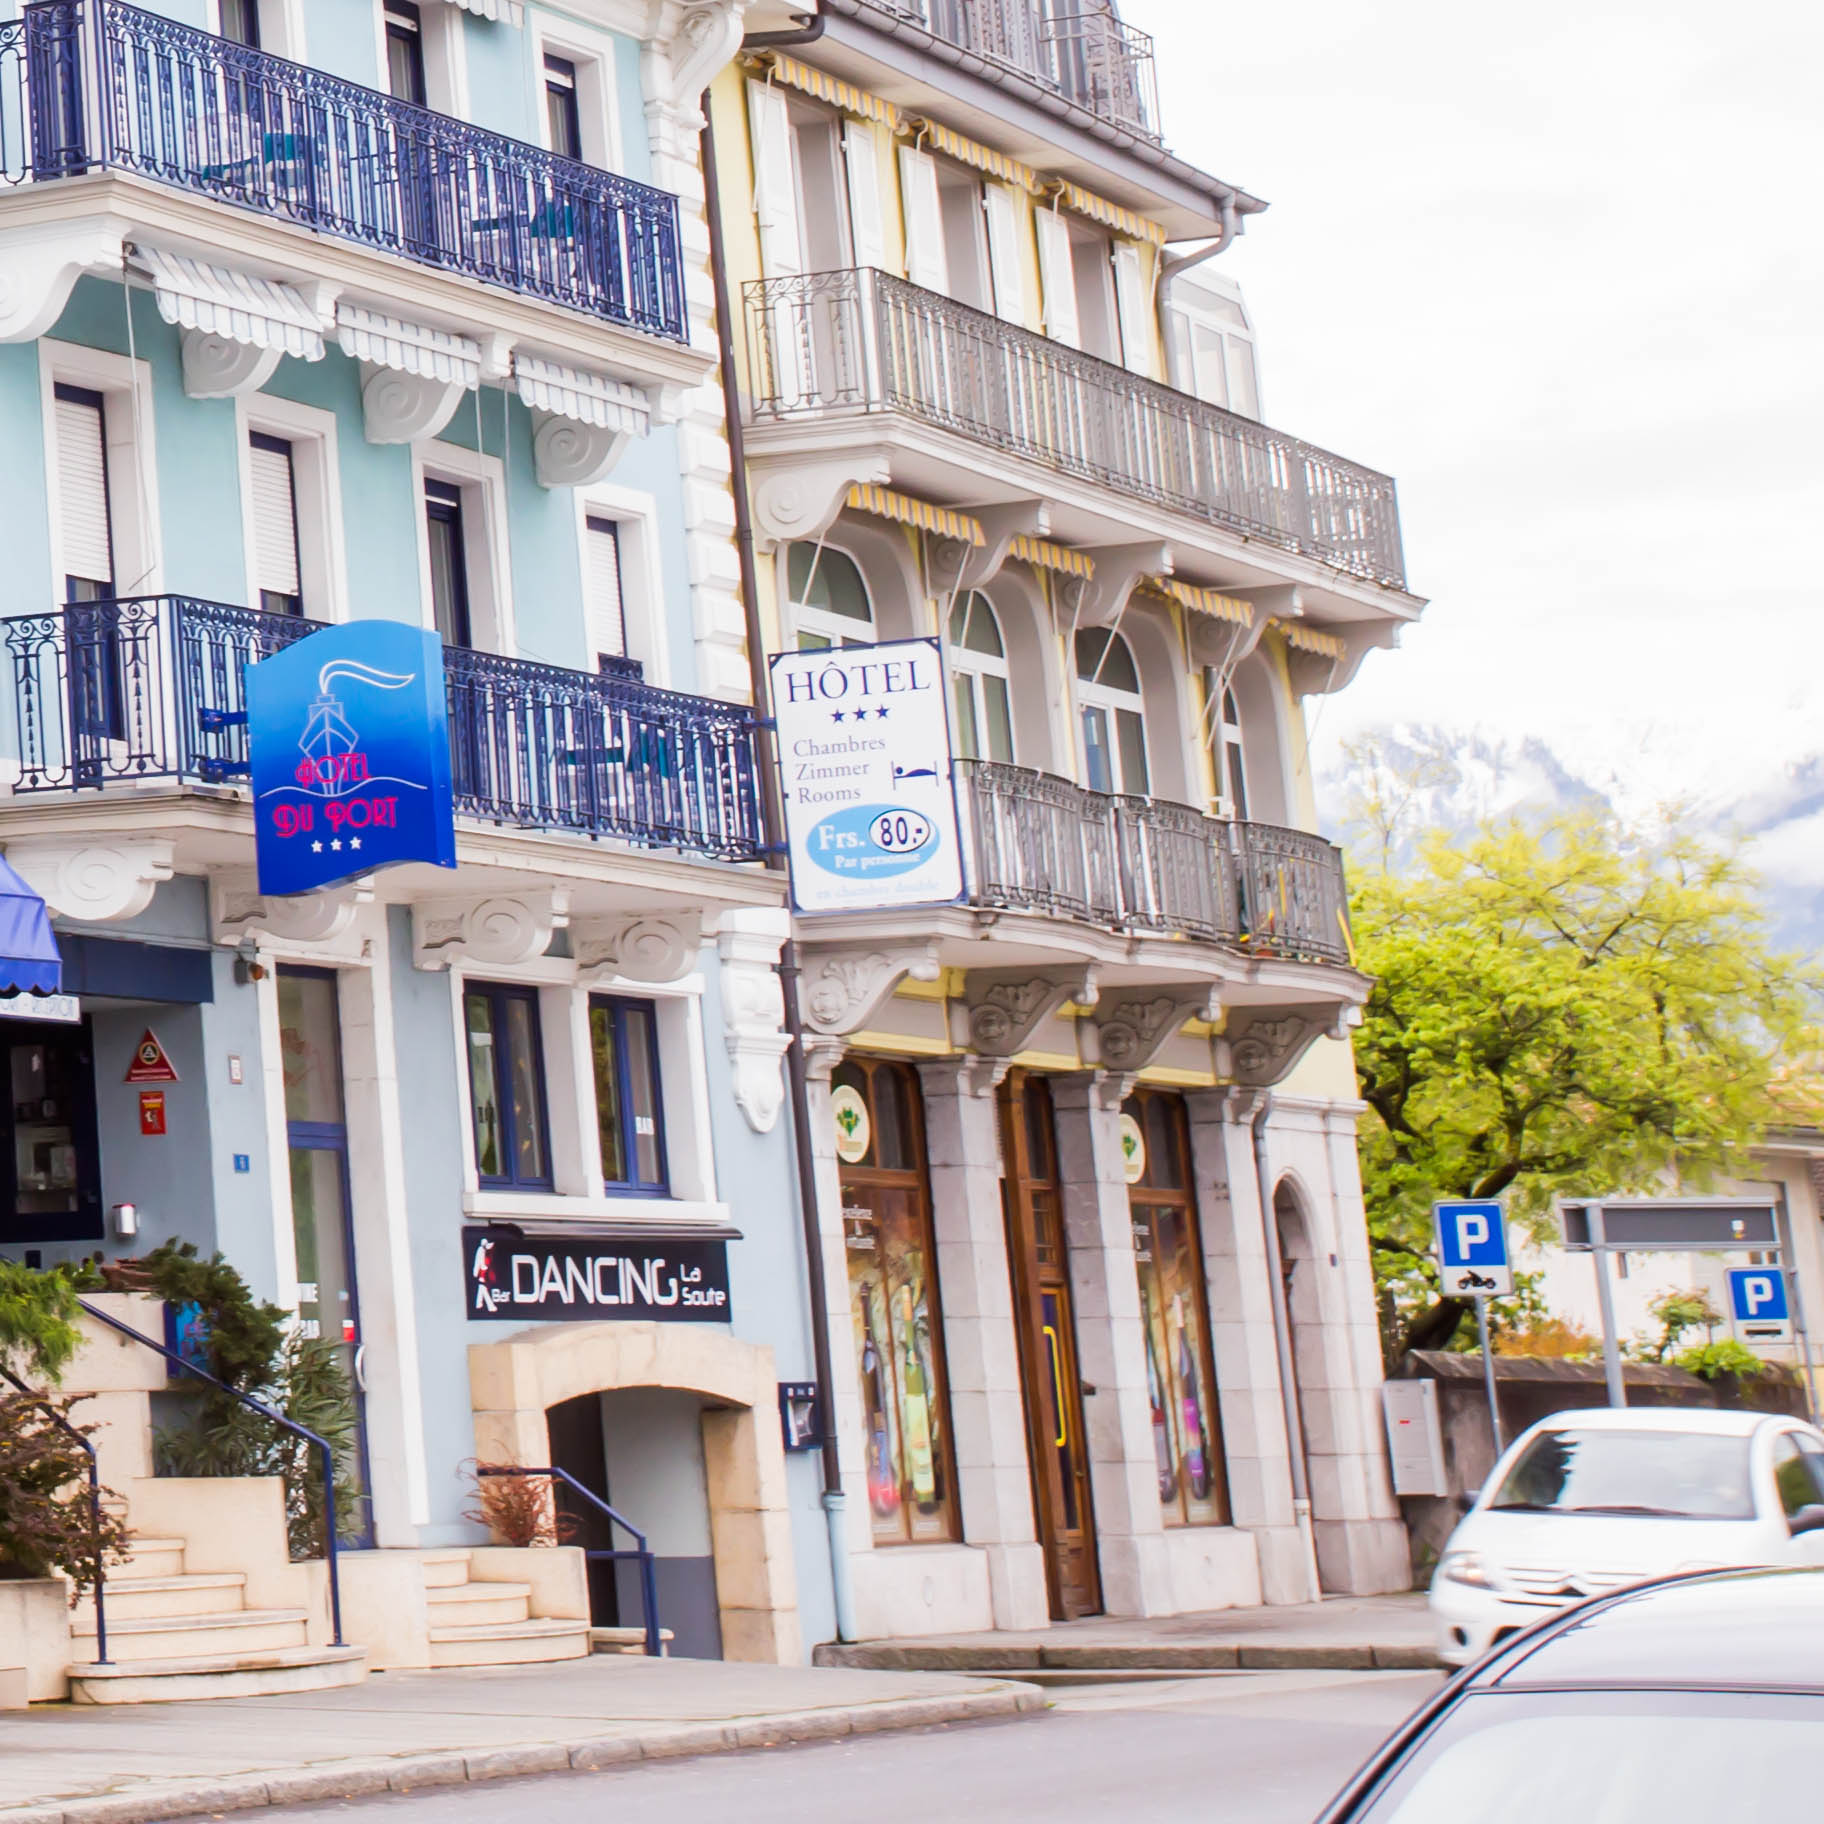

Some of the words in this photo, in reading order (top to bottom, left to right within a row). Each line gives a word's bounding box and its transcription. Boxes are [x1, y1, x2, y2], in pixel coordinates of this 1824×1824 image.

[785, 660, 931, 704] HÔTEL
[793, 735, 886, 758] Chambres
[295, 753, 372, 789] HOTEL
[795, 760, 870, 782] Zimmer
[798, 785, 862, 804] Rooms
[273, 804, 313, 839] DU
[324, 797, 399, 833] PORT
[817, 824, 867, 851] Frs.
[1456, 1214, 1490, 1261] P
[511, 1254, 678, 1306] DANCING
[680, 1263, 702, 1282] La
[492, 1289, 511, 1304] Bar
[682, 1287, 726, 1307] Soute
[1742, 1275, 1774, 1315] P
